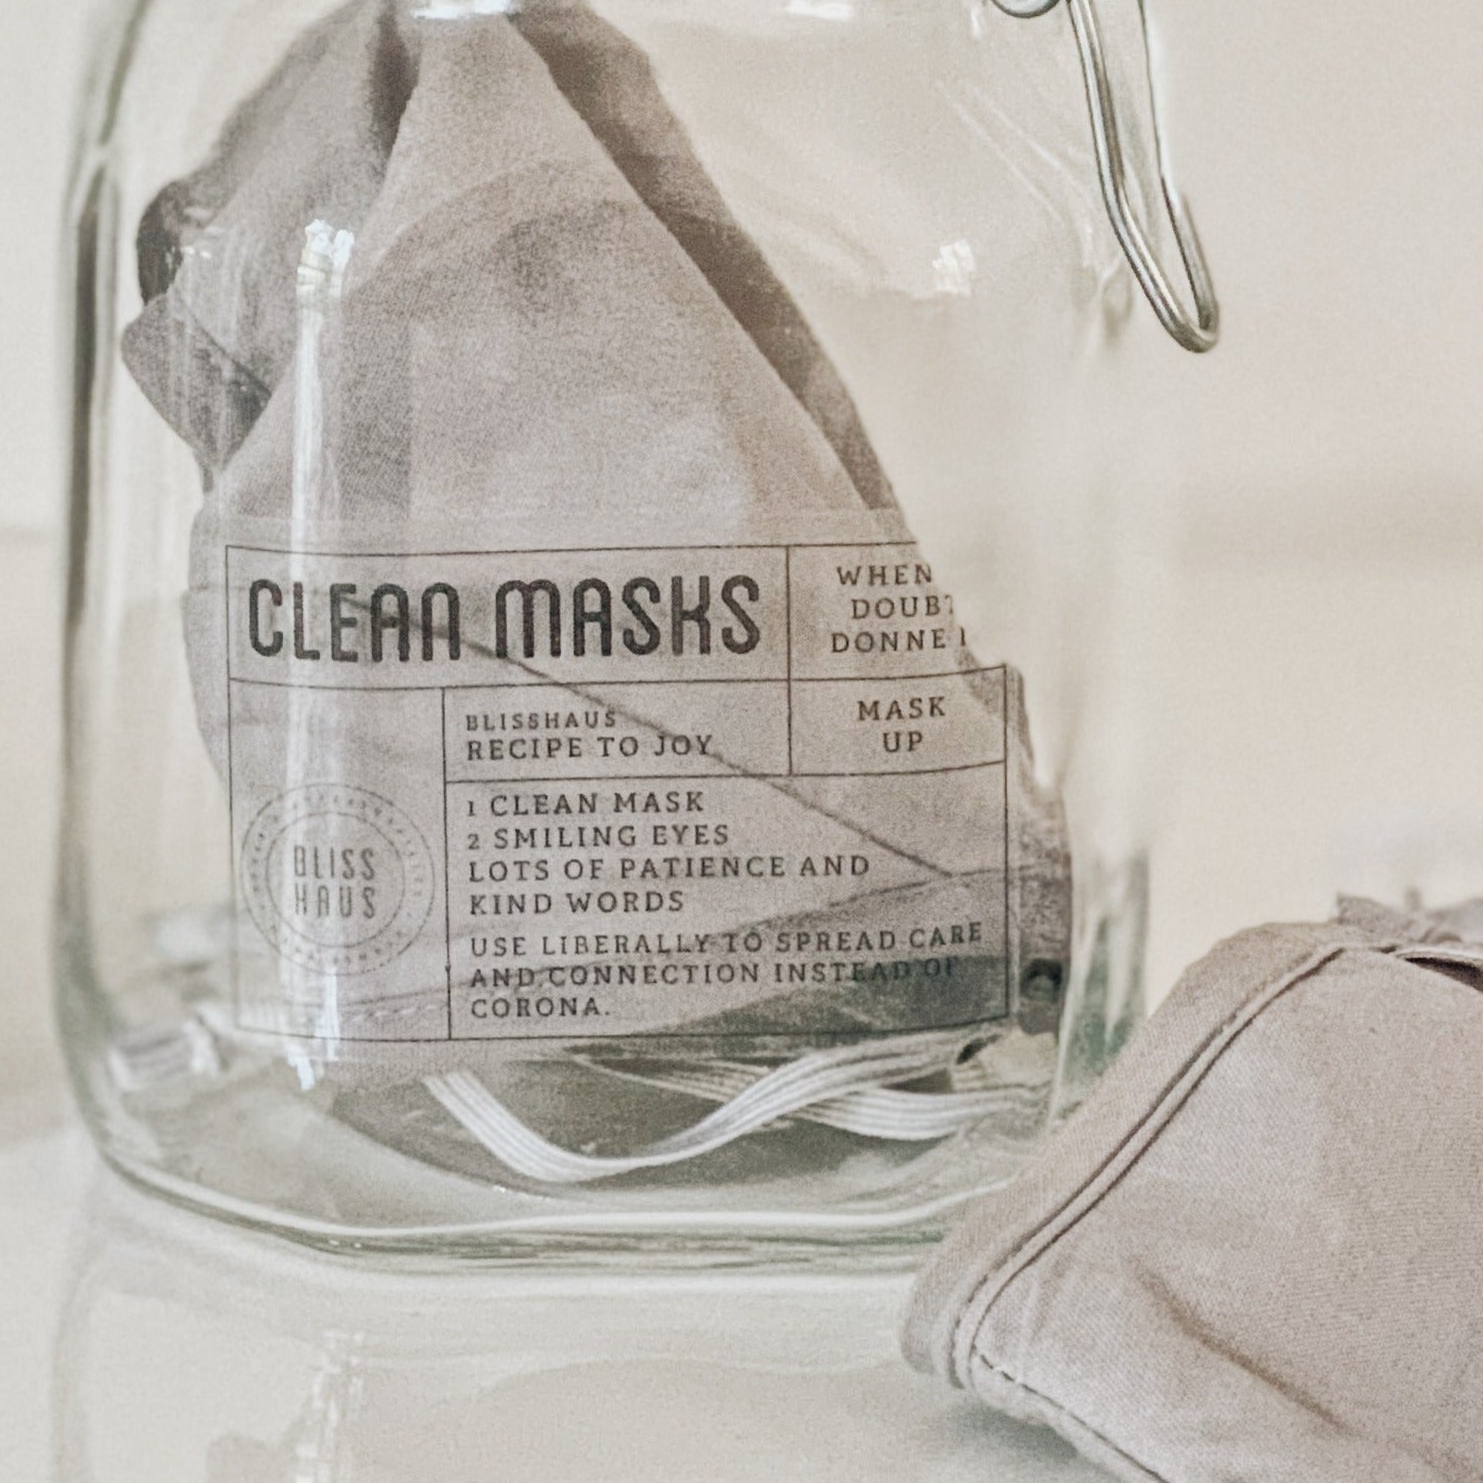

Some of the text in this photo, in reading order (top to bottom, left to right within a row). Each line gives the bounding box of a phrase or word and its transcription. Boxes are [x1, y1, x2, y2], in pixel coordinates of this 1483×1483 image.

[836, 563, 932, 587] WHEN
[249, 574, 761, 665] CLEAN MASKS
[831, 628, 946, 654] DONNE
[466, 712, 617, 732] BLISSHAUS
[857, 696, 945, 722] MASK
[466, 734, 713, 761] RECIPE TO JOY
[883, 730, 923, 754] UP
[490, 791, 598, 817] CLEAN
[613, 791, 704, 813] MASK
[467, 824, 728, 851] 2 SMILING EYES
[294, 846, 375, 880] BLISS
[469, 854, 869, 883] LOTS OF PATIENCE AND
[296, 883, 375, 919] HAUS
[470, 890, 683, 916] KIND WORDS
[471, 921, 981, 958] USE LIBERALLY TO SPREAD CARE
[470, 968, 535, 988] AND
[547, 961, 759, 987] CONNECTION
[775, 962, 911, 984] INSTEAD
[470, 995, 610, 1019] CORONA.
